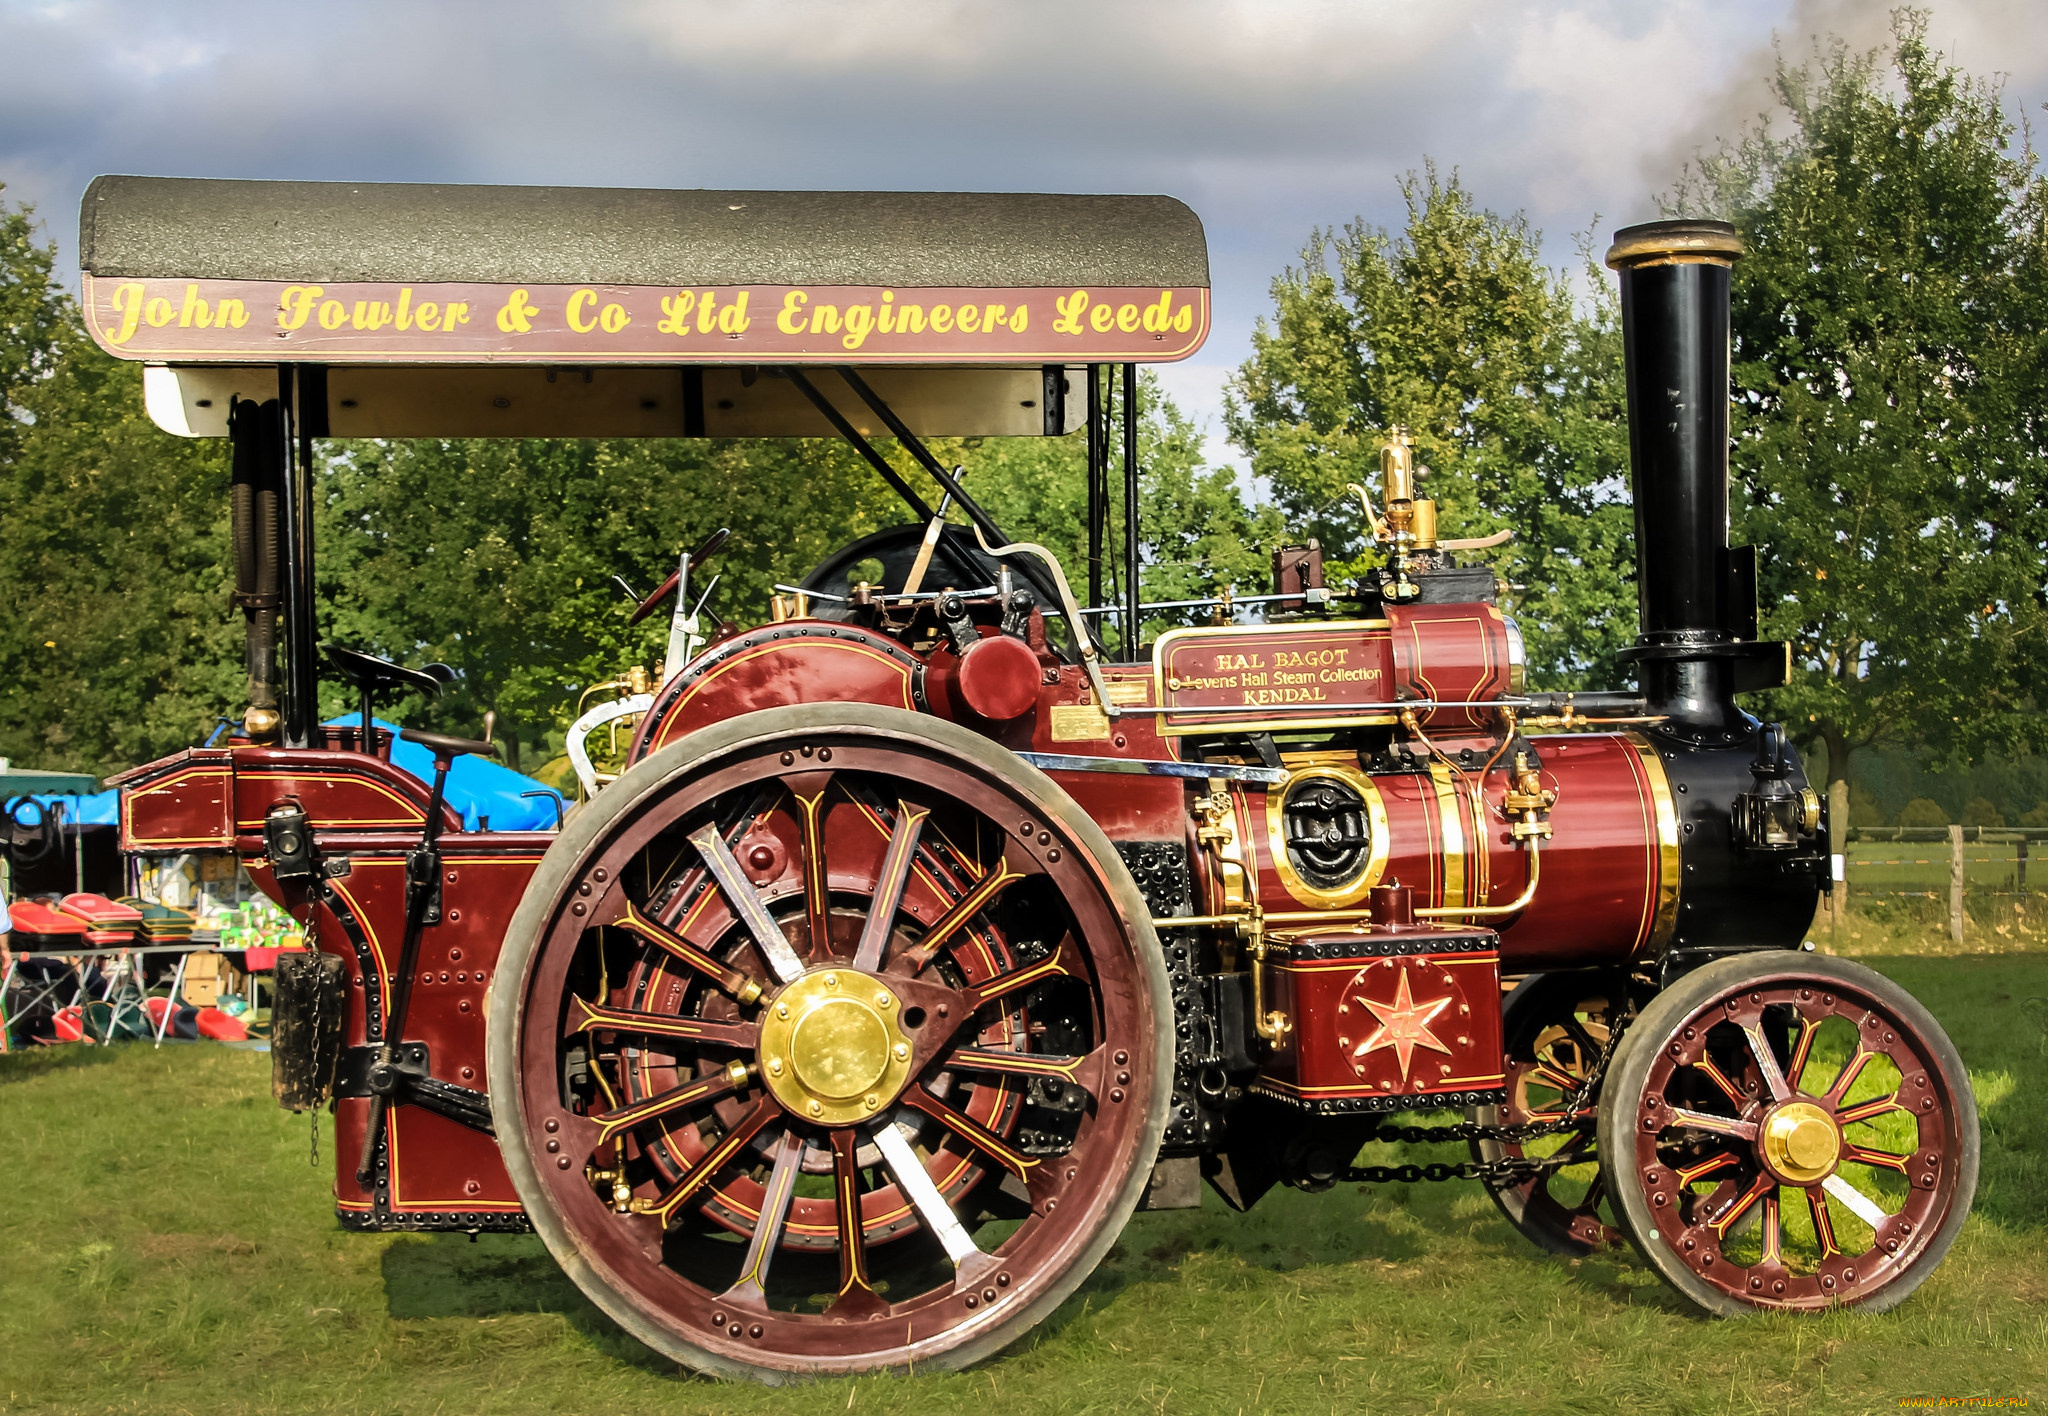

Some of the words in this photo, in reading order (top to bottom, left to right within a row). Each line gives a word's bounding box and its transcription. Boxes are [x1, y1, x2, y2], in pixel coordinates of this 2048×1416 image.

[106, 282, 250, 345] John
[278, 285, 470, 333] Fowler
[496, 289, 539, 334] &
[565, 288, 631, 334] Co
[657, 290, 750, 337] Ltd
[776, 289, 1029, 350] Engineers
[1052, 290, 1193, 336] Leeds
[1215, 653, 1265, 671] HAL
[1274, 648, 1349, 668] BAGOT
[1241, 672, 1268, 687] Hall
[1273, 670, 1316, 686] Steam
[1320, 667, 1383, 684] Collection
[1243, 687, 1327, 706] KENDAL
